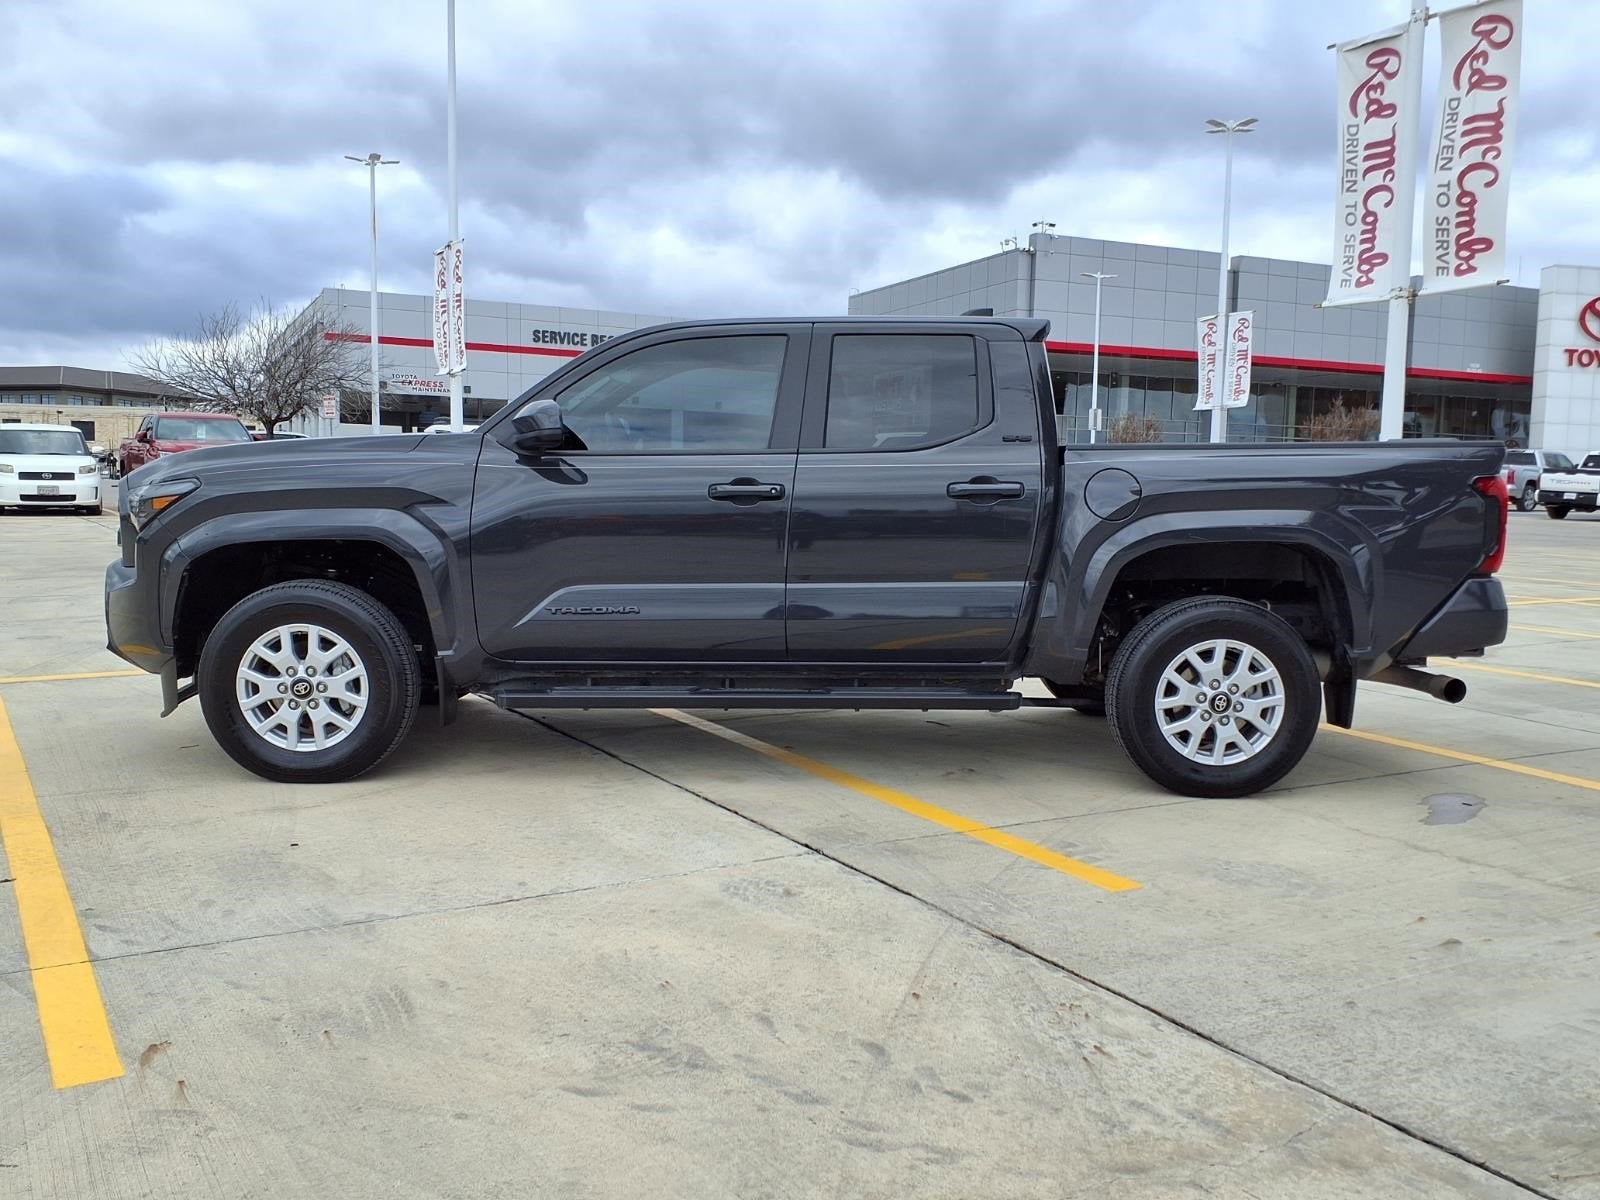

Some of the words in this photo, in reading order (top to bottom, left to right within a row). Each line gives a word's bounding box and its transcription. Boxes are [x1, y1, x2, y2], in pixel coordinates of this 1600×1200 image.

[1453, 14, 1514, 97] Red
[1350, 47, 1402, 124] Red
[1440, 97, 1461, 172] DRIVEN
[1345, 124, 1359, 193] DRIVEN
[1436, 181, 1450, 208] TO
[1345, 200, 1357, 227] TO
[1435, 215, 1450, 277] SERVE
[1340, 234, 1356, 288] SERVE
[532, 329, 588, 347] SERVICE
[1202, 322, 1217, 347] Red
[1233, 317, 1250, 343] Red
[401, 379, 444, 388] EXPRESS
[544, 606, 641, 615] TACOMA
